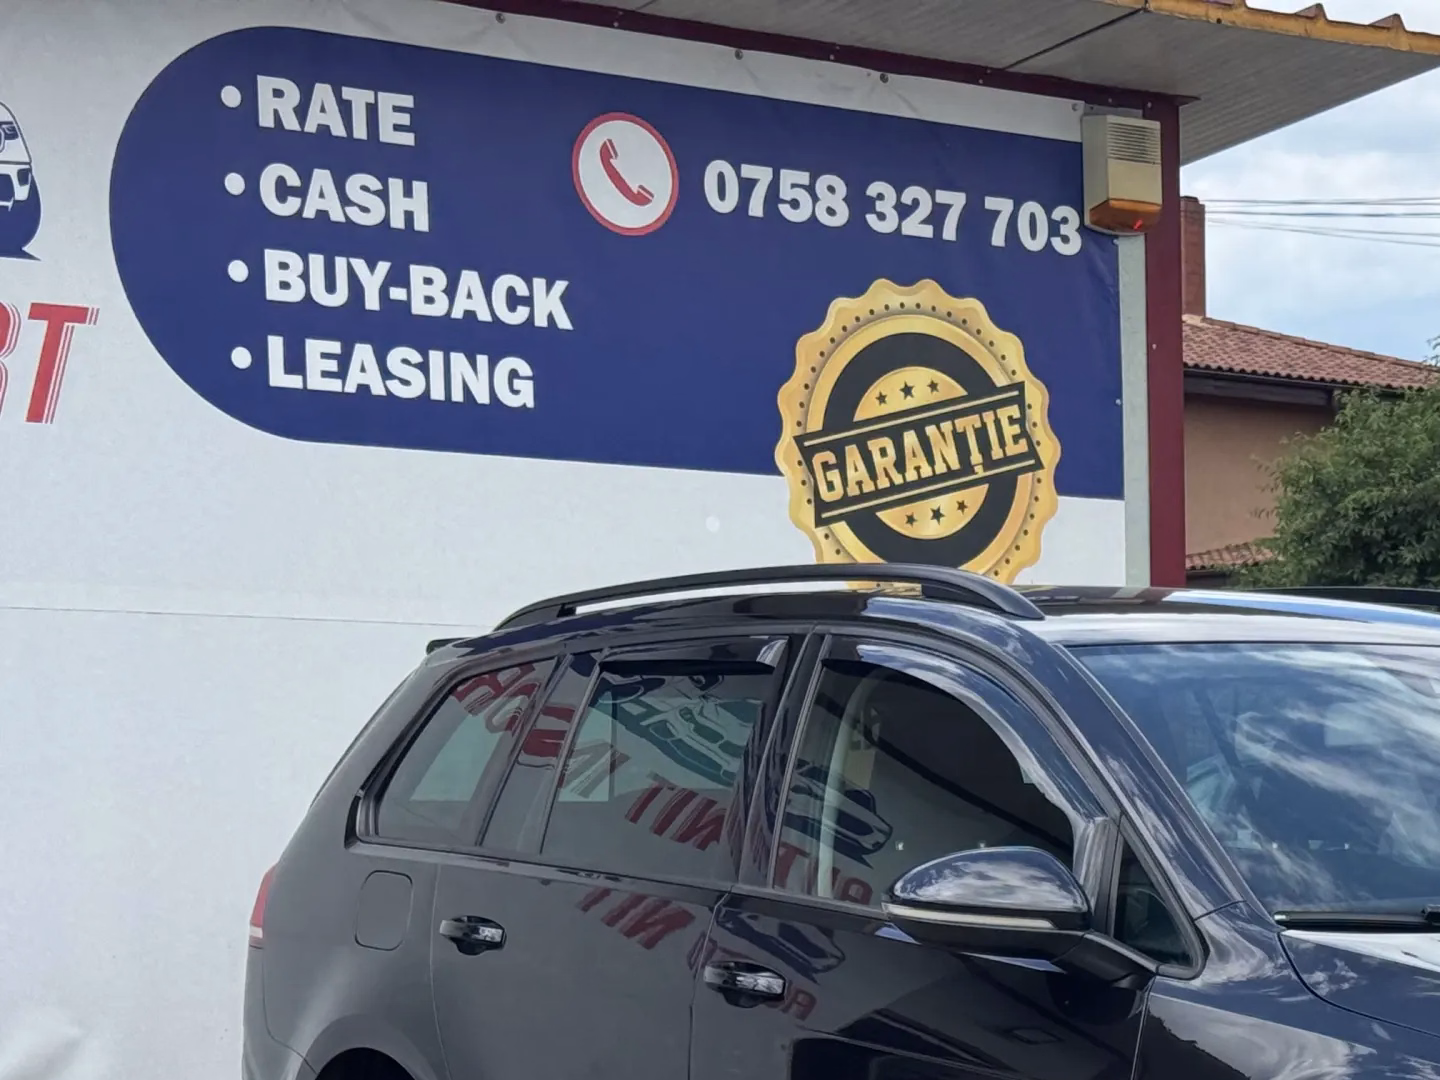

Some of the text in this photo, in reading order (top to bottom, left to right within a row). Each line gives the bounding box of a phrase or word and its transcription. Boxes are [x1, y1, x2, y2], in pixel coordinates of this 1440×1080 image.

[257, 75, 415, 146] RATE
[259, 163, 430, 233] CASH
[703, 159, 1082, 256] 0758 327 703
[263, 248, 574, 331] BUY-BACK
[267, 334, 535, 409] LEASING
